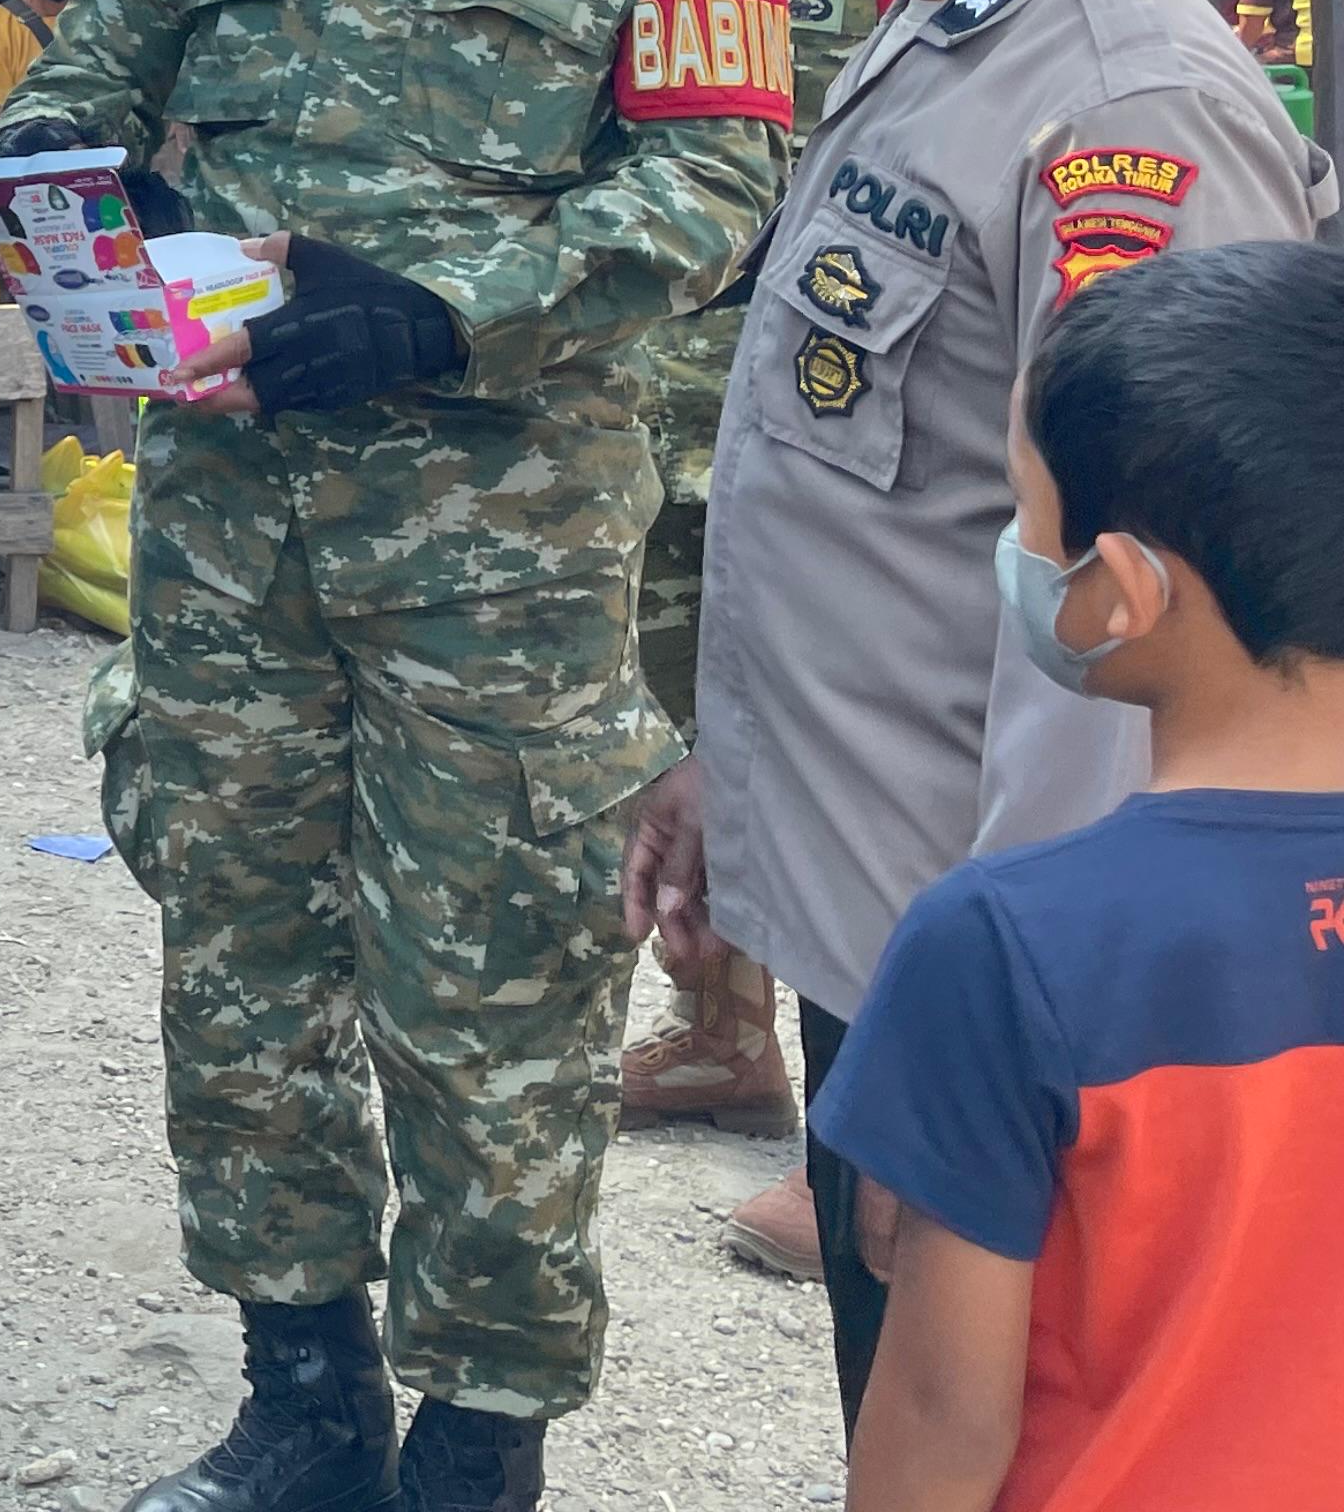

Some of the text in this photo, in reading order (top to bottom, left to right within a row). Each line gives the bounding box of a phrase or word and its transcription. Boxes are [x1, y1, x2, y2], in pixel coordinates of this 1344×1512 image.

[1052, 154, 1179, 181] POLRES
[1057, 169, 1174, 197] KOLAKA TIMUR
[829, 157, 950, 258] POLRI
